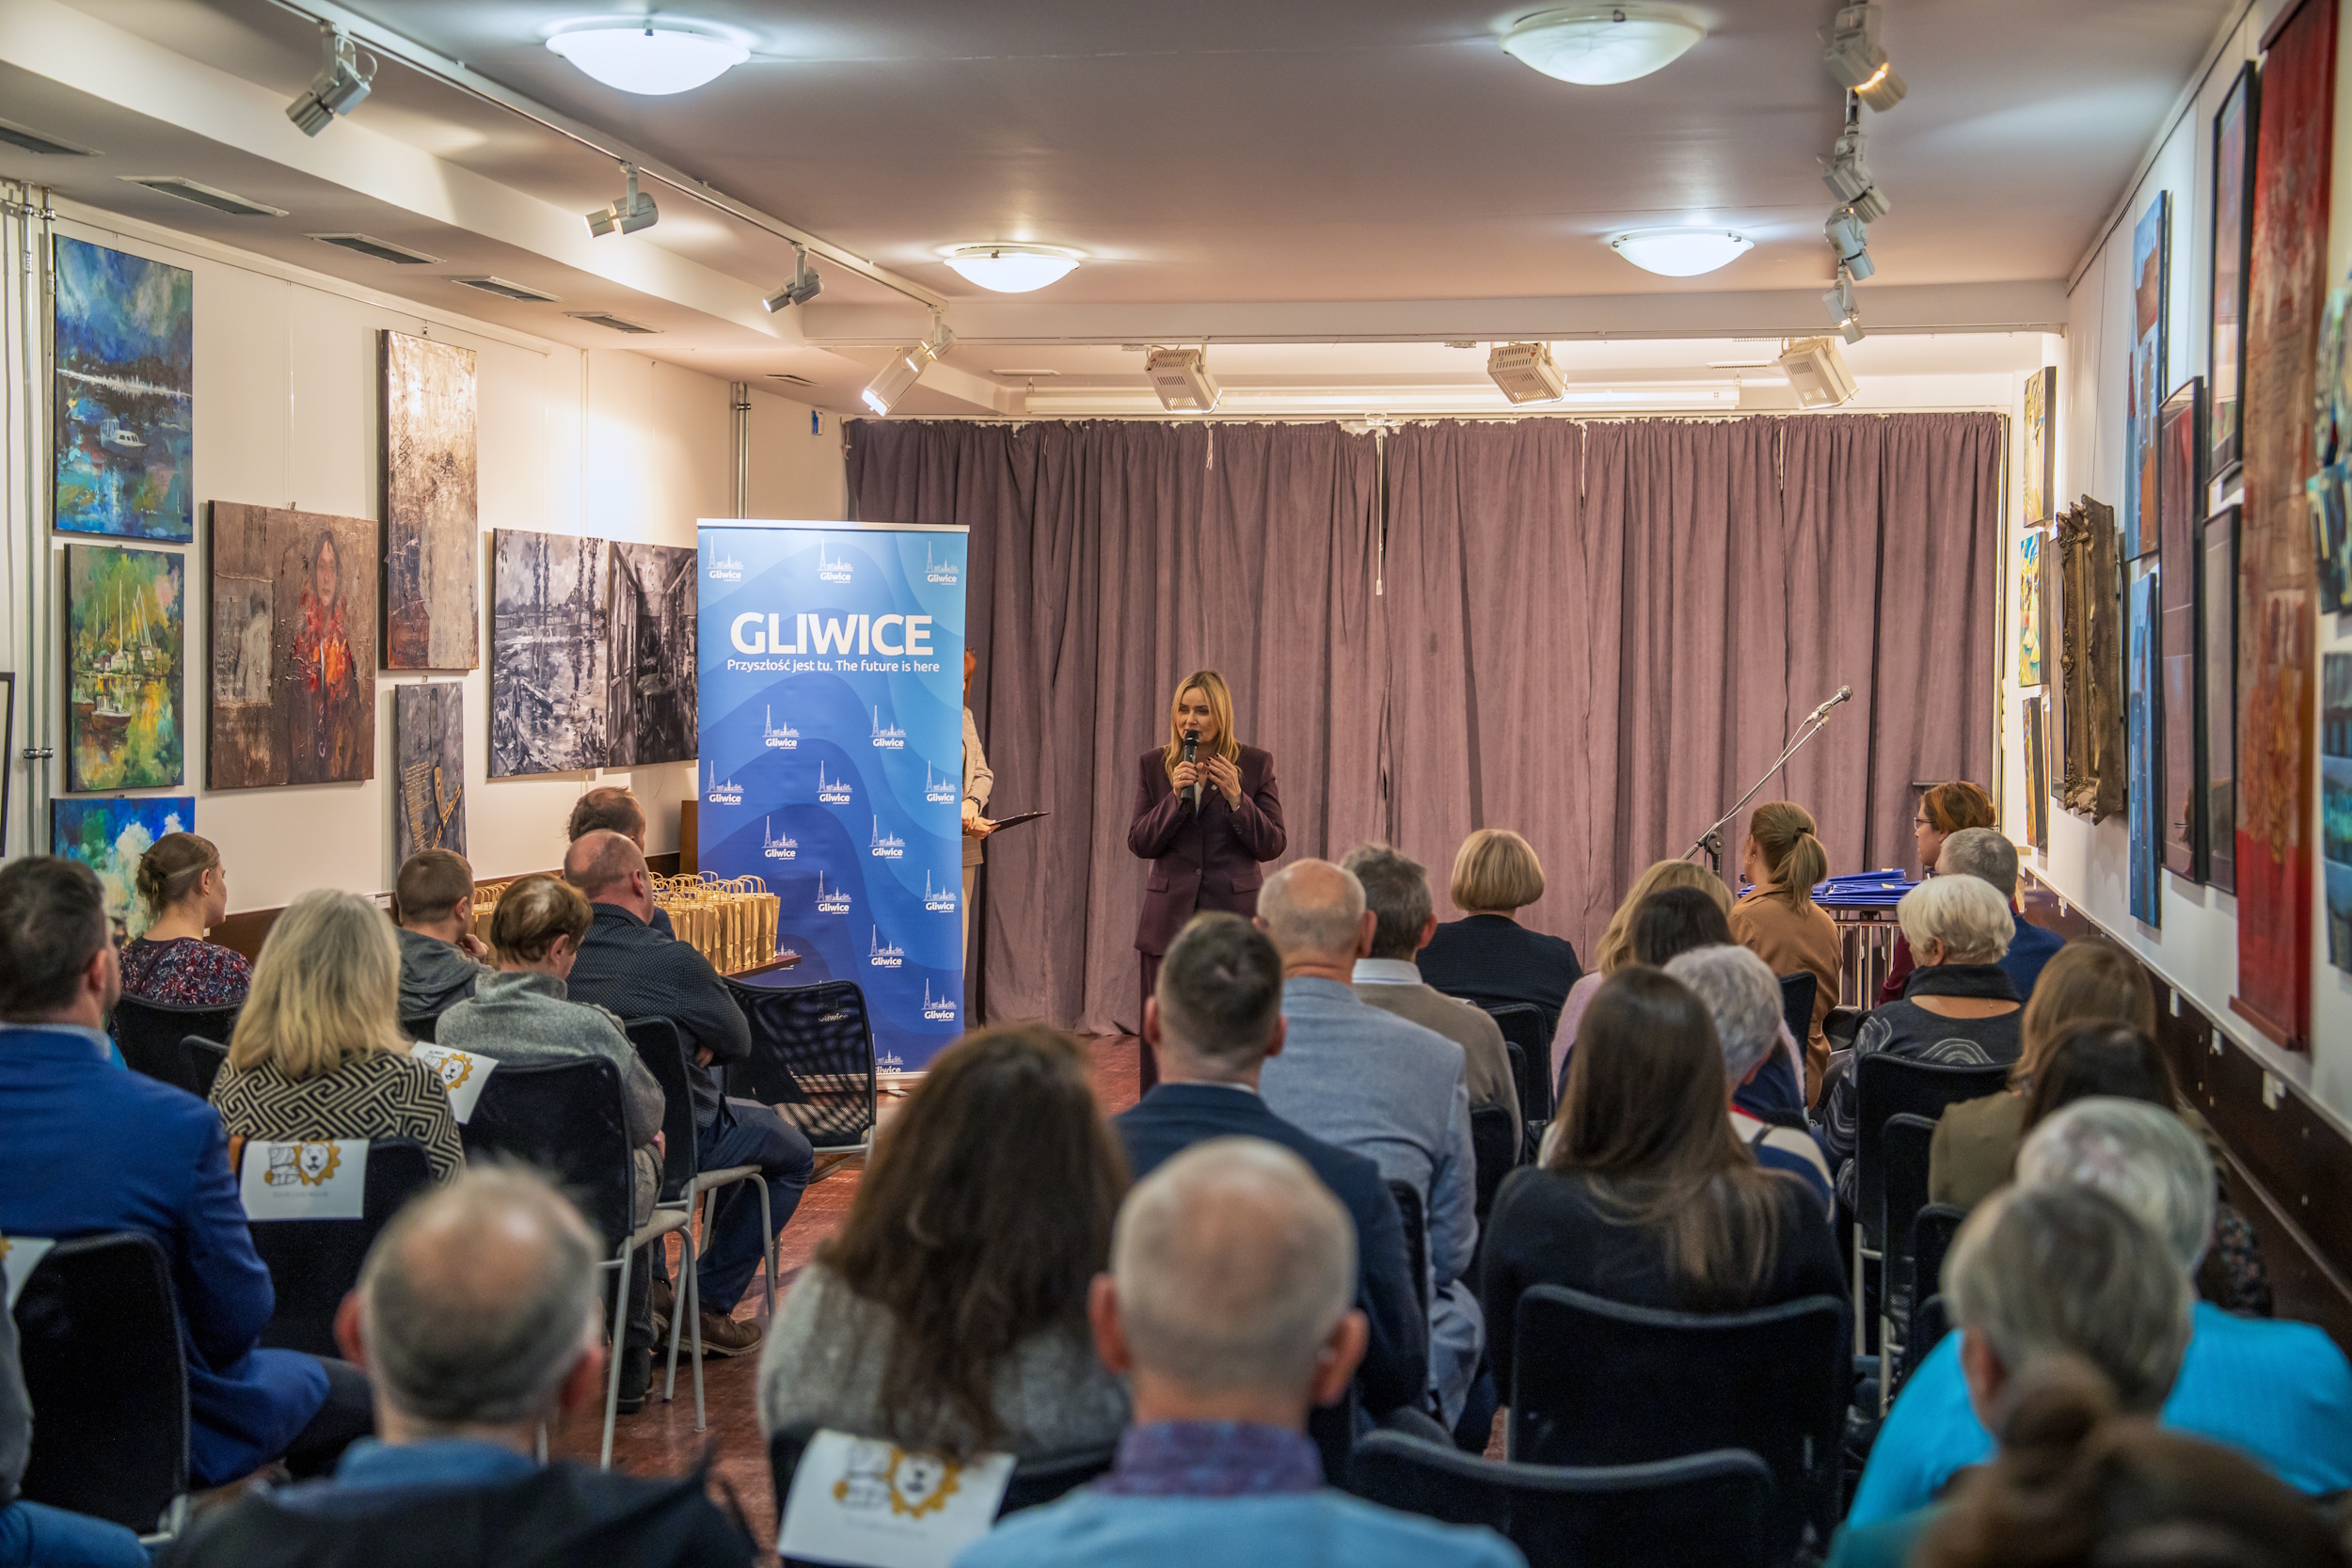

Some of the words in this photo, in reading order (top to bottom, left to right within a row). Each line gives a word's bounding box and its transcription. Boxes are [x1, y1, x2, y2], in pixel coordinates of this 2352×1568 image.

[708, 570, 742, 580] Gliwice
[819, 571, 851, 581] Gliwice
[927, 574, 958, 583] Gliwice
[730, 611, 934, 657] GLIWICE
[726, 658, 792, 673] Przyszłość
[791, 660, 815, 673] jest
[817, 660, 834, 672] tu.
[835, 659, 858, 672] The
[860, 659, 899, 673] future
[901, 660, 912, 673] is
[914, 660, 940, 673] here
[765, 737, 798, 748] Gliwice
[872, 737, 905, 748] Gliwice
[708, 793, 742, 803] Gliwice
[818, 793, 850, 803] Gliwice
[926, 793, 955, 802] Gliwice
[764, 848, 796, 858] Gliwice
[871, 847, 903, 857] Gliwice
[818, 903, 850, 912] Gliwice
[925, 901, 955, 911] Gliwice
[871, 957, 903, 966] Gliwice
[924, 1010, 955, 1020] Gliwice
